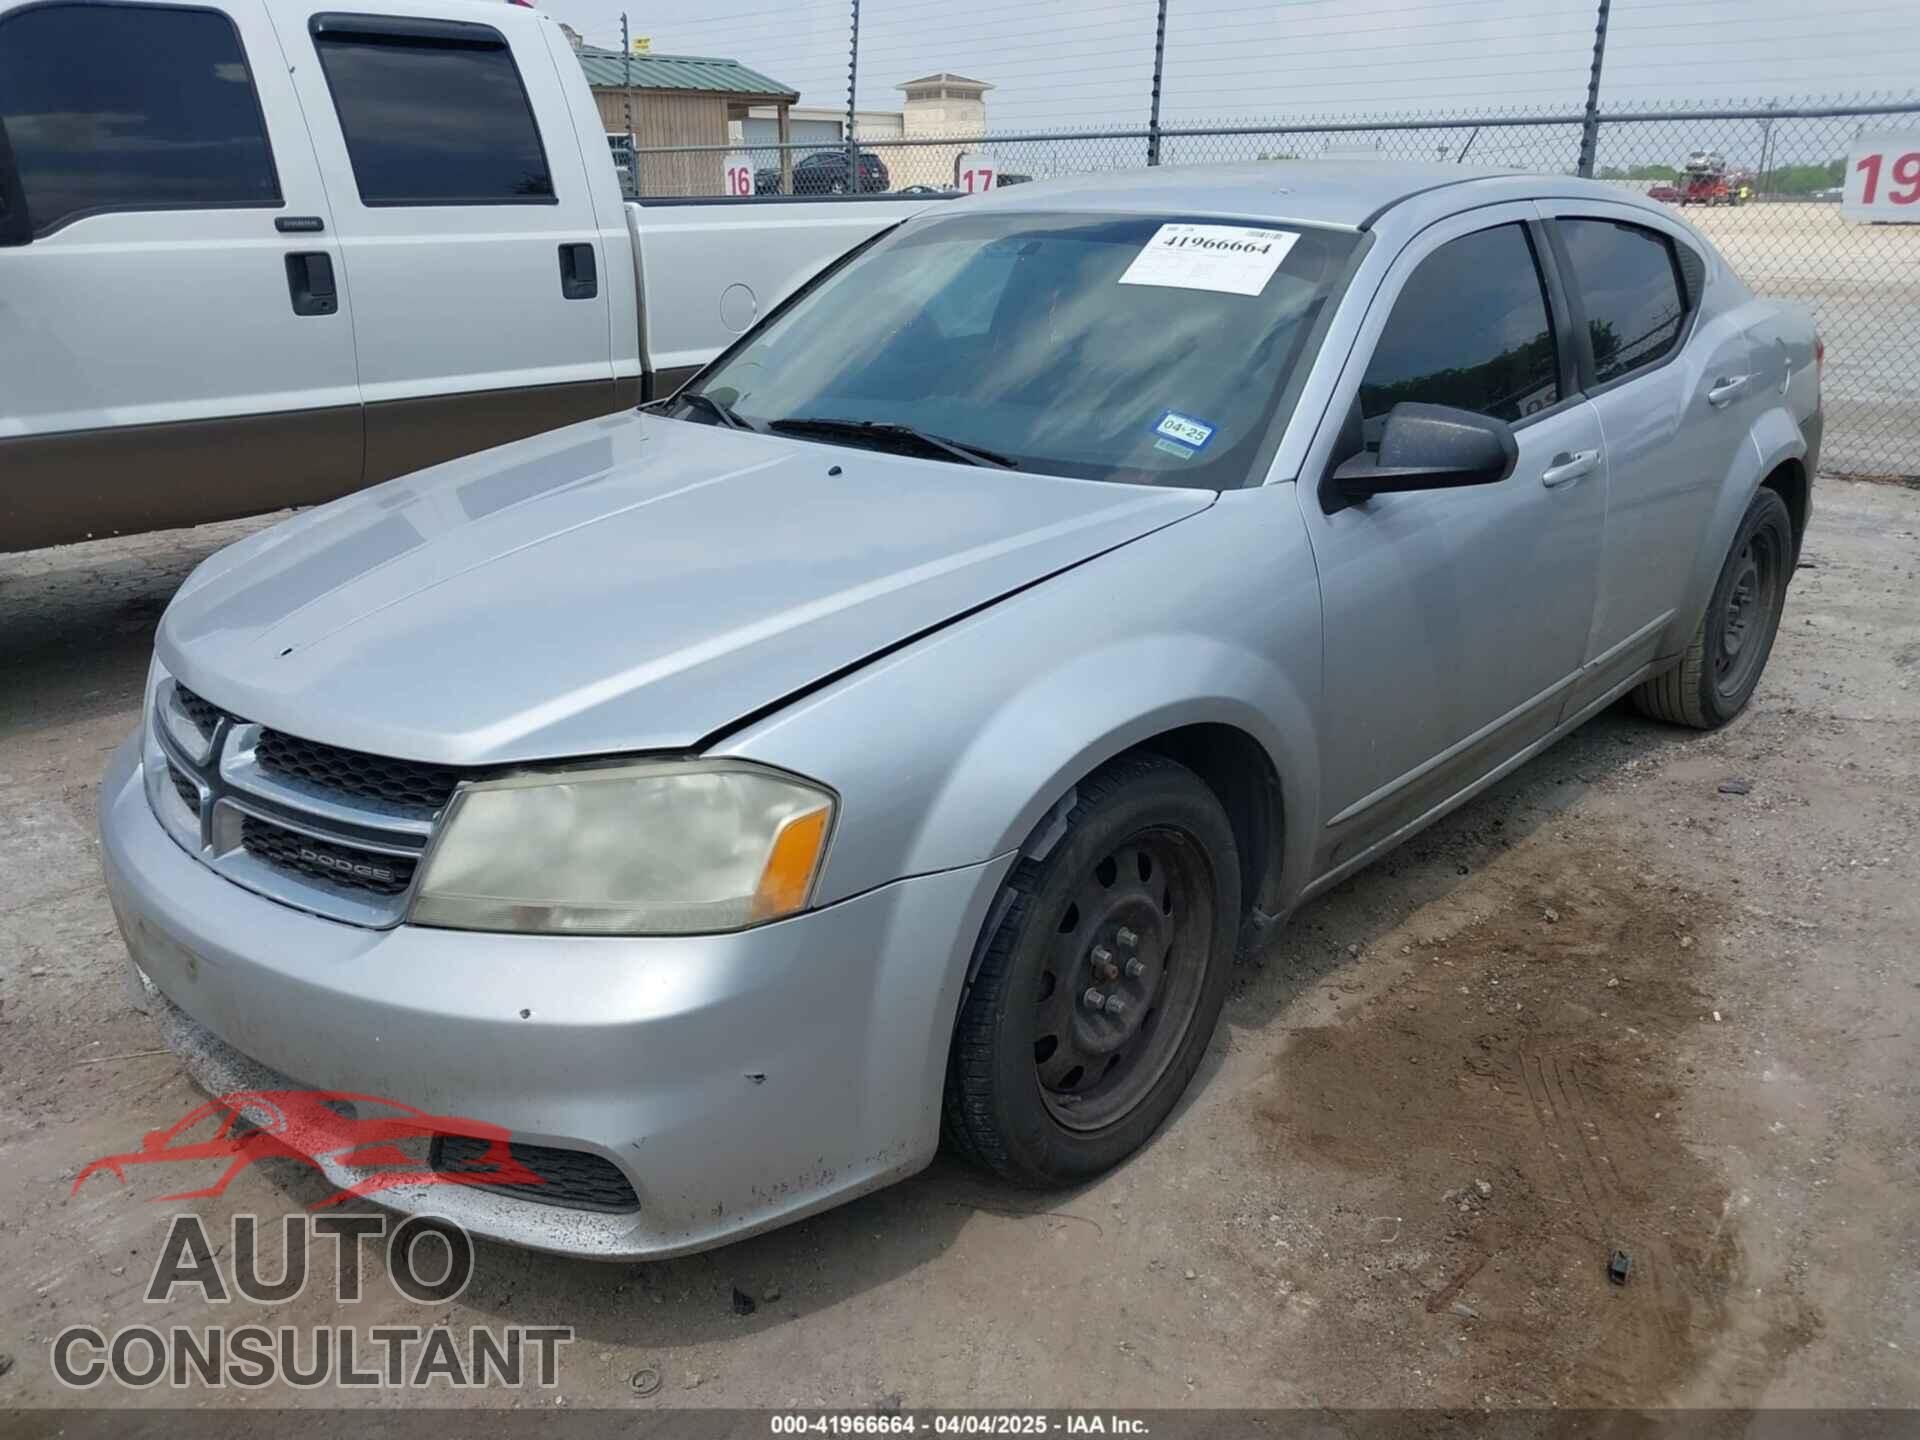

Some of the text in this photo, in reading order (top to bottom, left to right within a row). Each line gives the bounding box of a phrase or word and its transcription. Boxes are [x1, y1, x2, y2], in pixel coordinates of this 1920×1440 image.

[727, 167, 750, 196] 16
[962, 170, 993, 194] 17
[1856, 152, 1920, 206] 19
[1163, 235, 1273, 255] 41966664
[302, 849, 391, 880] DODGE
